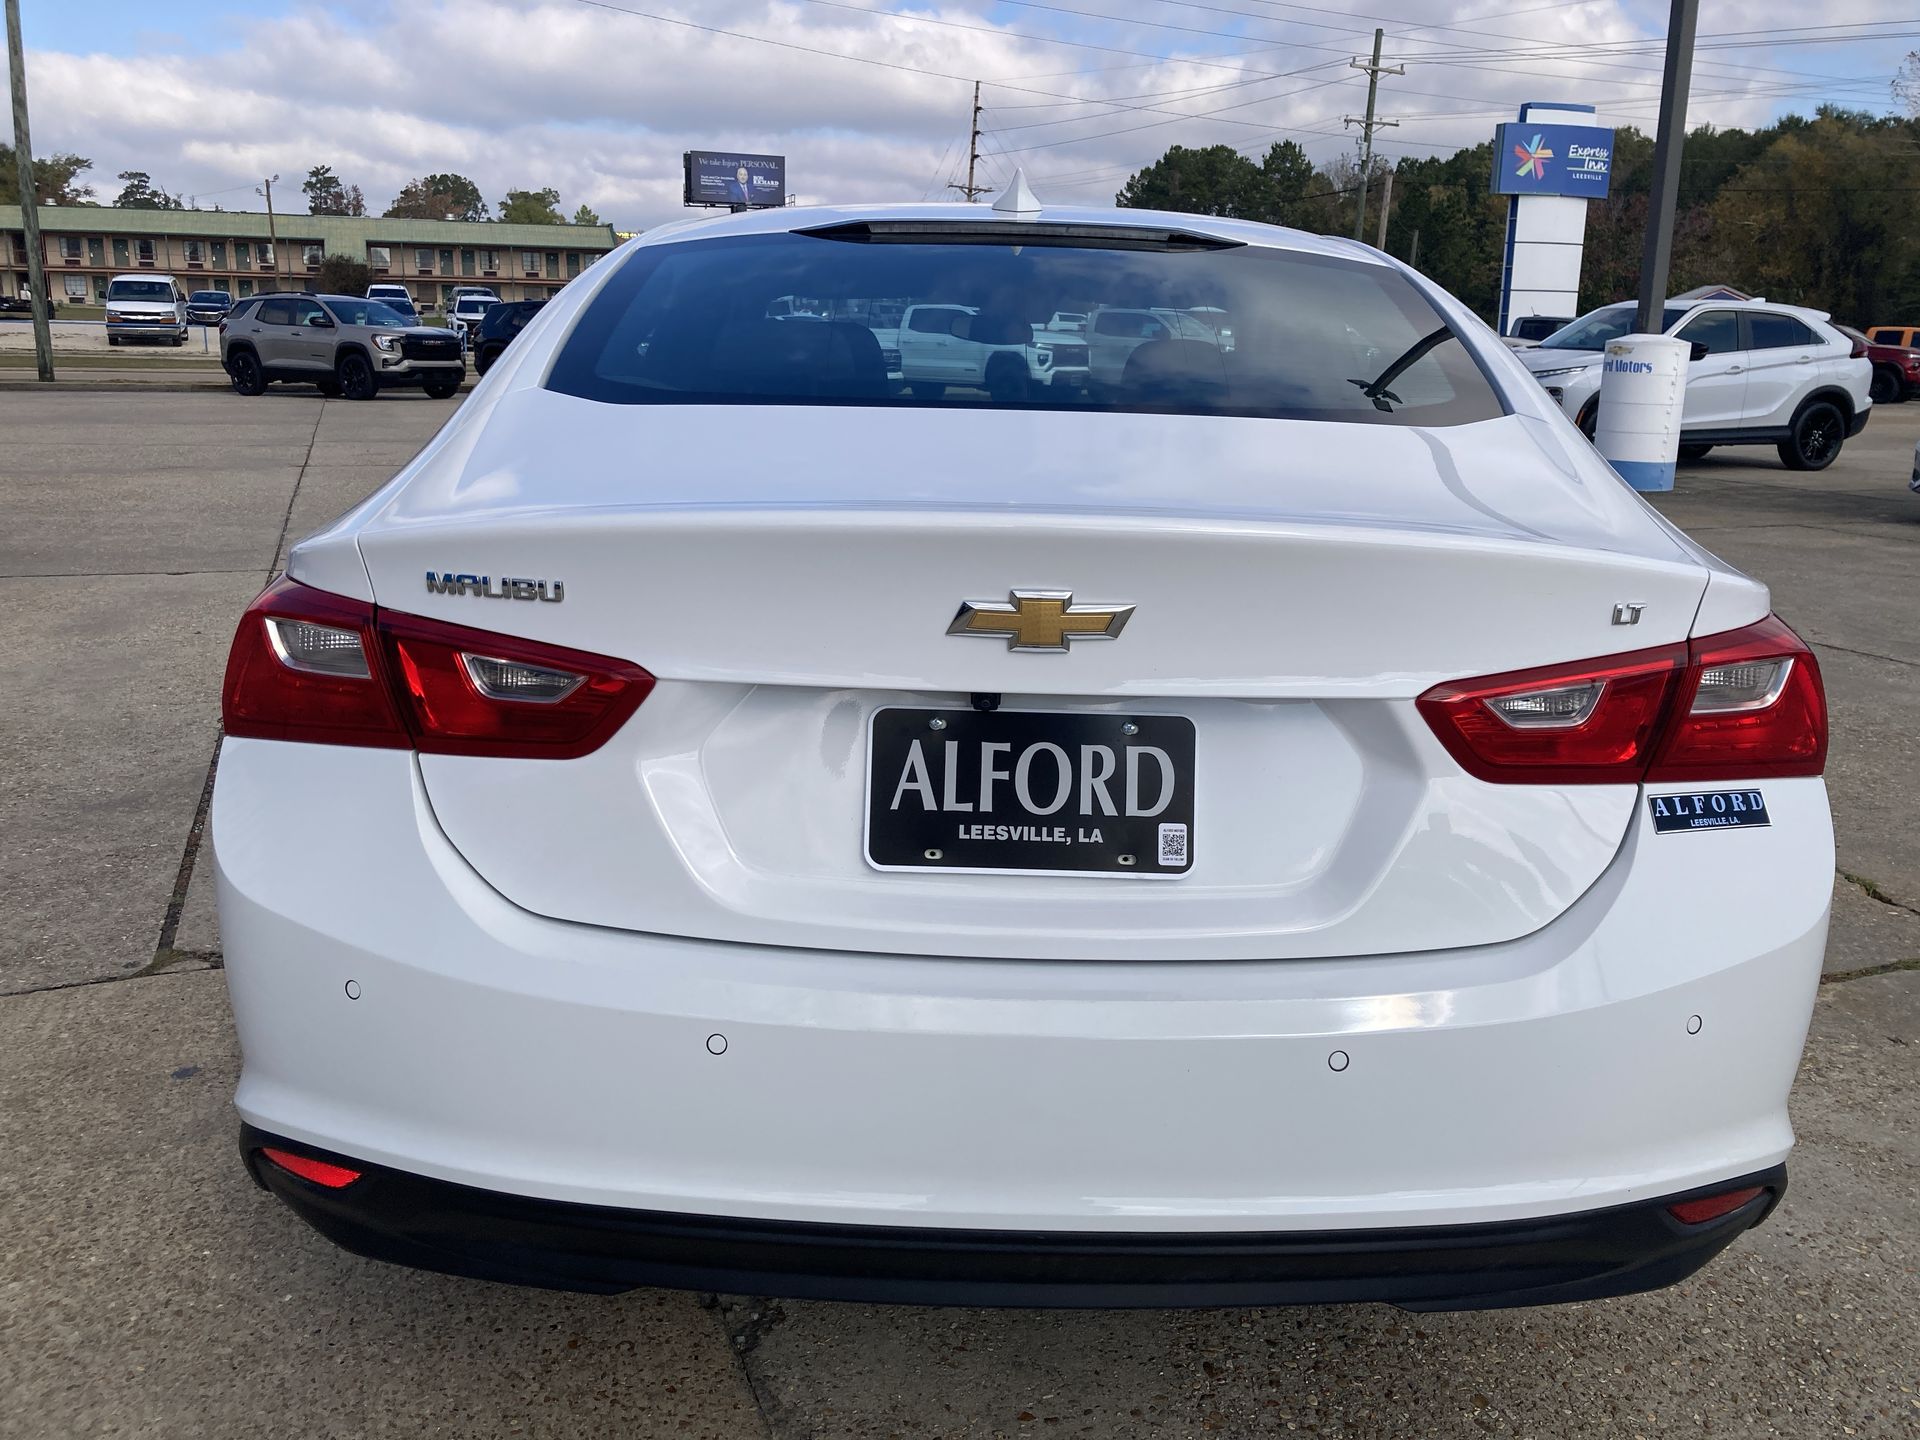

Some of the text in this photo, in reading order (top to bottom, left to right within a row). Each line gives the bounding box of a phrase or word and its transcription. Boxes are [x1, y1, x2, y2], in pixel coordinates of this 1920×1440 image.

[1569, 144, 1609, 159] Express
[1584, 157, 1608, 170] Inn
[1615, 359, 1653, 374] Motors
[426, 571, 564, 602] MALIBU
[1611, 602, 1647, 625] LT
[890, 739, 1175, 817] ALFORD
[1655, 793, 1763, 816] ALFORD
[958, 824, 1104, 845] LEESVILLE, LA
